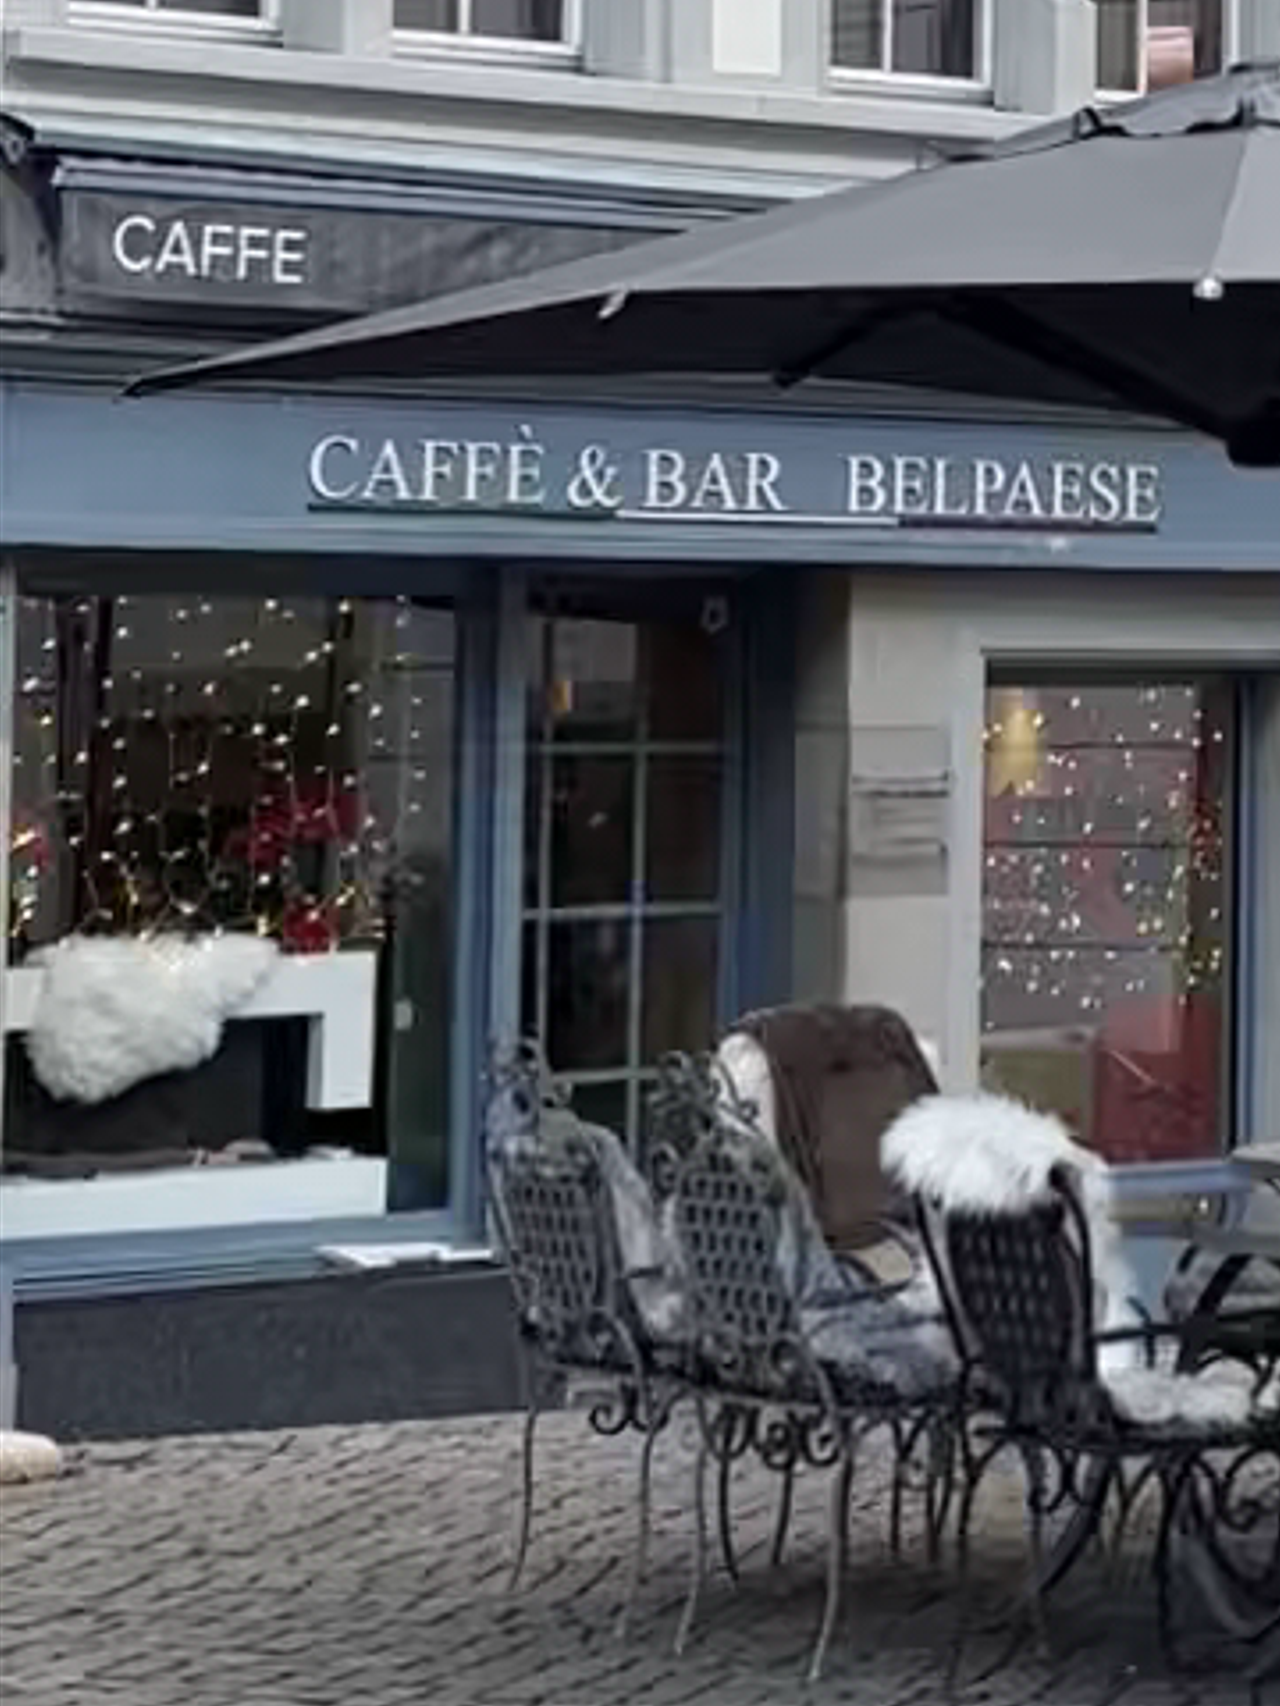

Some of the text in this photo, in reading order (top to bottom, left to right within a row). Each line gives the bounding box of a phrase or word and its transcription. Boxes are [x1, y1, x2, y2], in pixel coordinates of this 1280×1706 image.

[113, 214, 308, 284] CAFFE
[308, 423, 1161, 523] CAFFÈ & BAR BELPAESE
